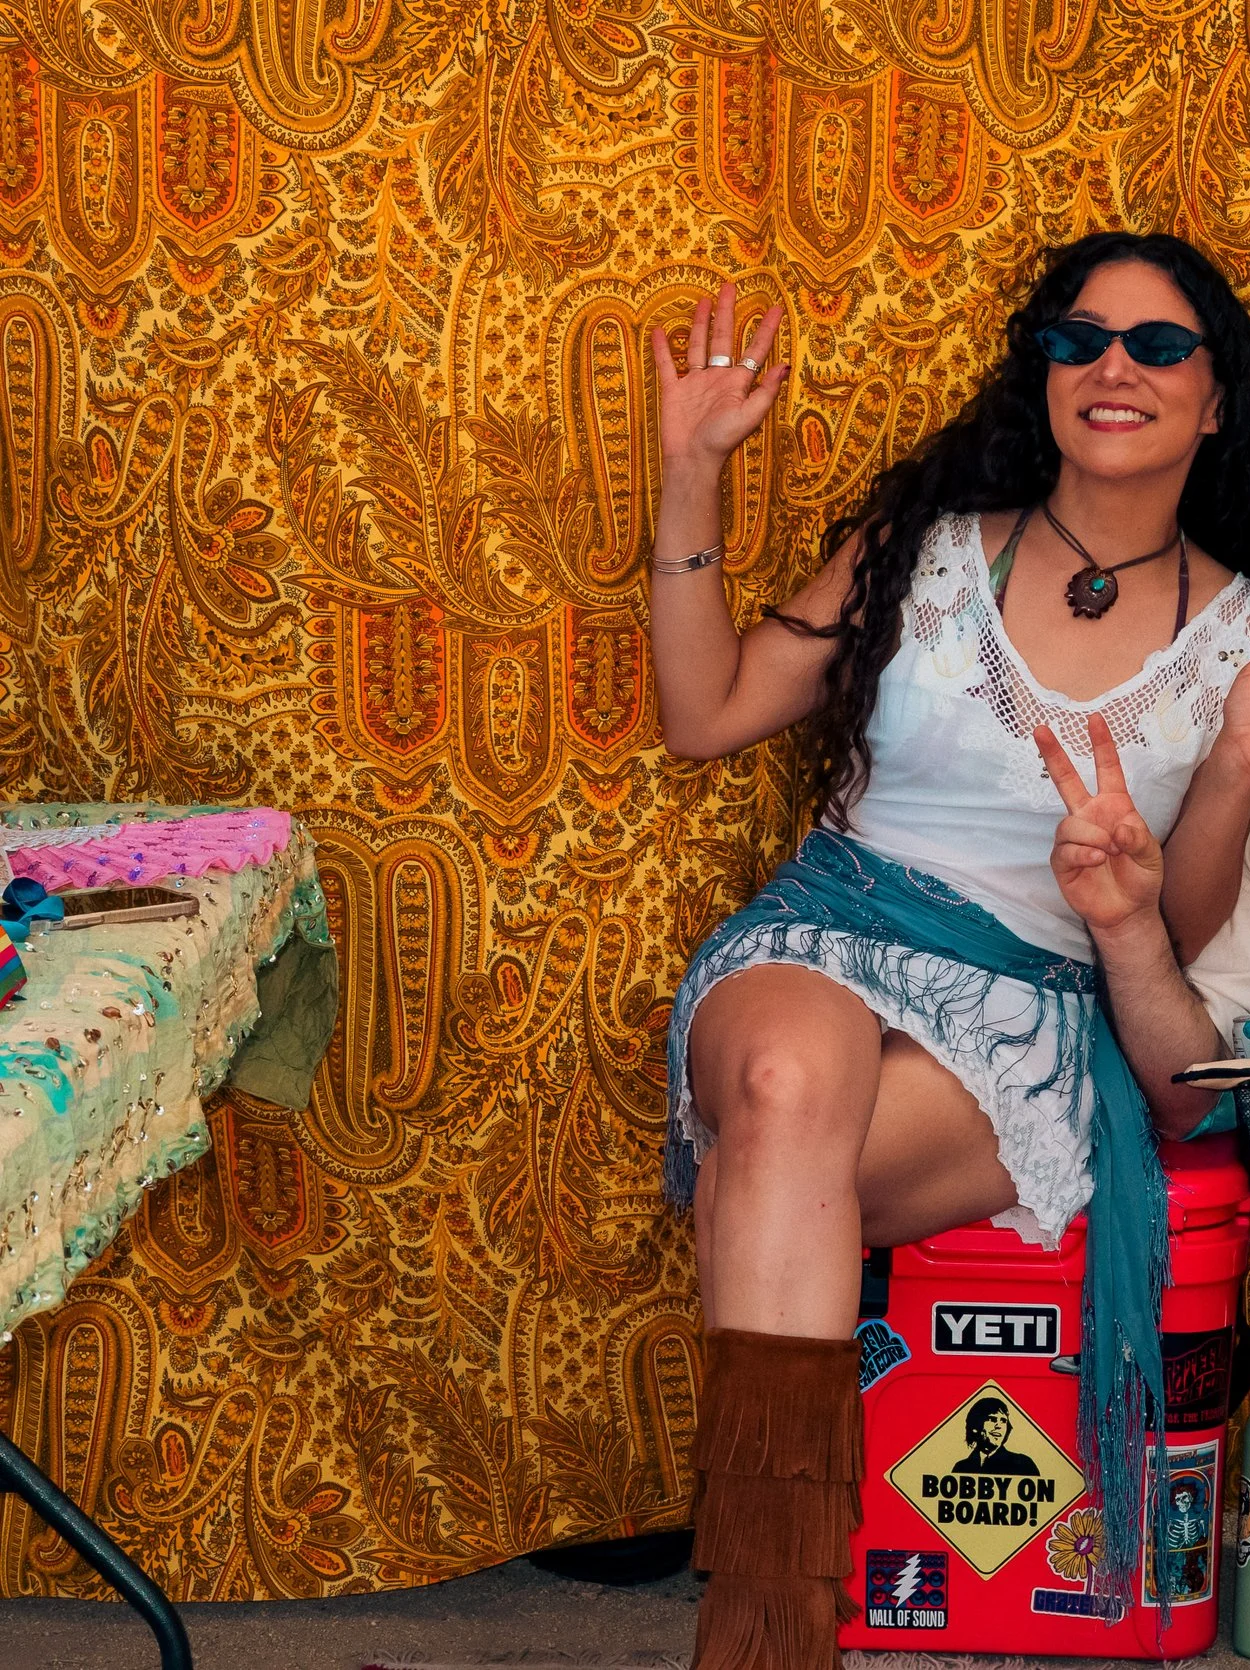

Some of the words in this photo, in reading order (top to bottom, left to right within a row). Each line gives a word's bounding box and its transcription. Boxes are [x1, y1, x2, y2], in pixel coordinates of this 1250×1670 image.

[940, 1313, 1048, 1347] YETI
[922, 1474, 1012, 1501] BOBBY
[1017, 1478, 1055, 1502] ON
[938, 1500, 1037, 1527] BOARD!
[869, 1608, 895, 1627] WALL
[897, 1609, 911, 1627] OF
[912, 1609, 946, 1628] SOUND
